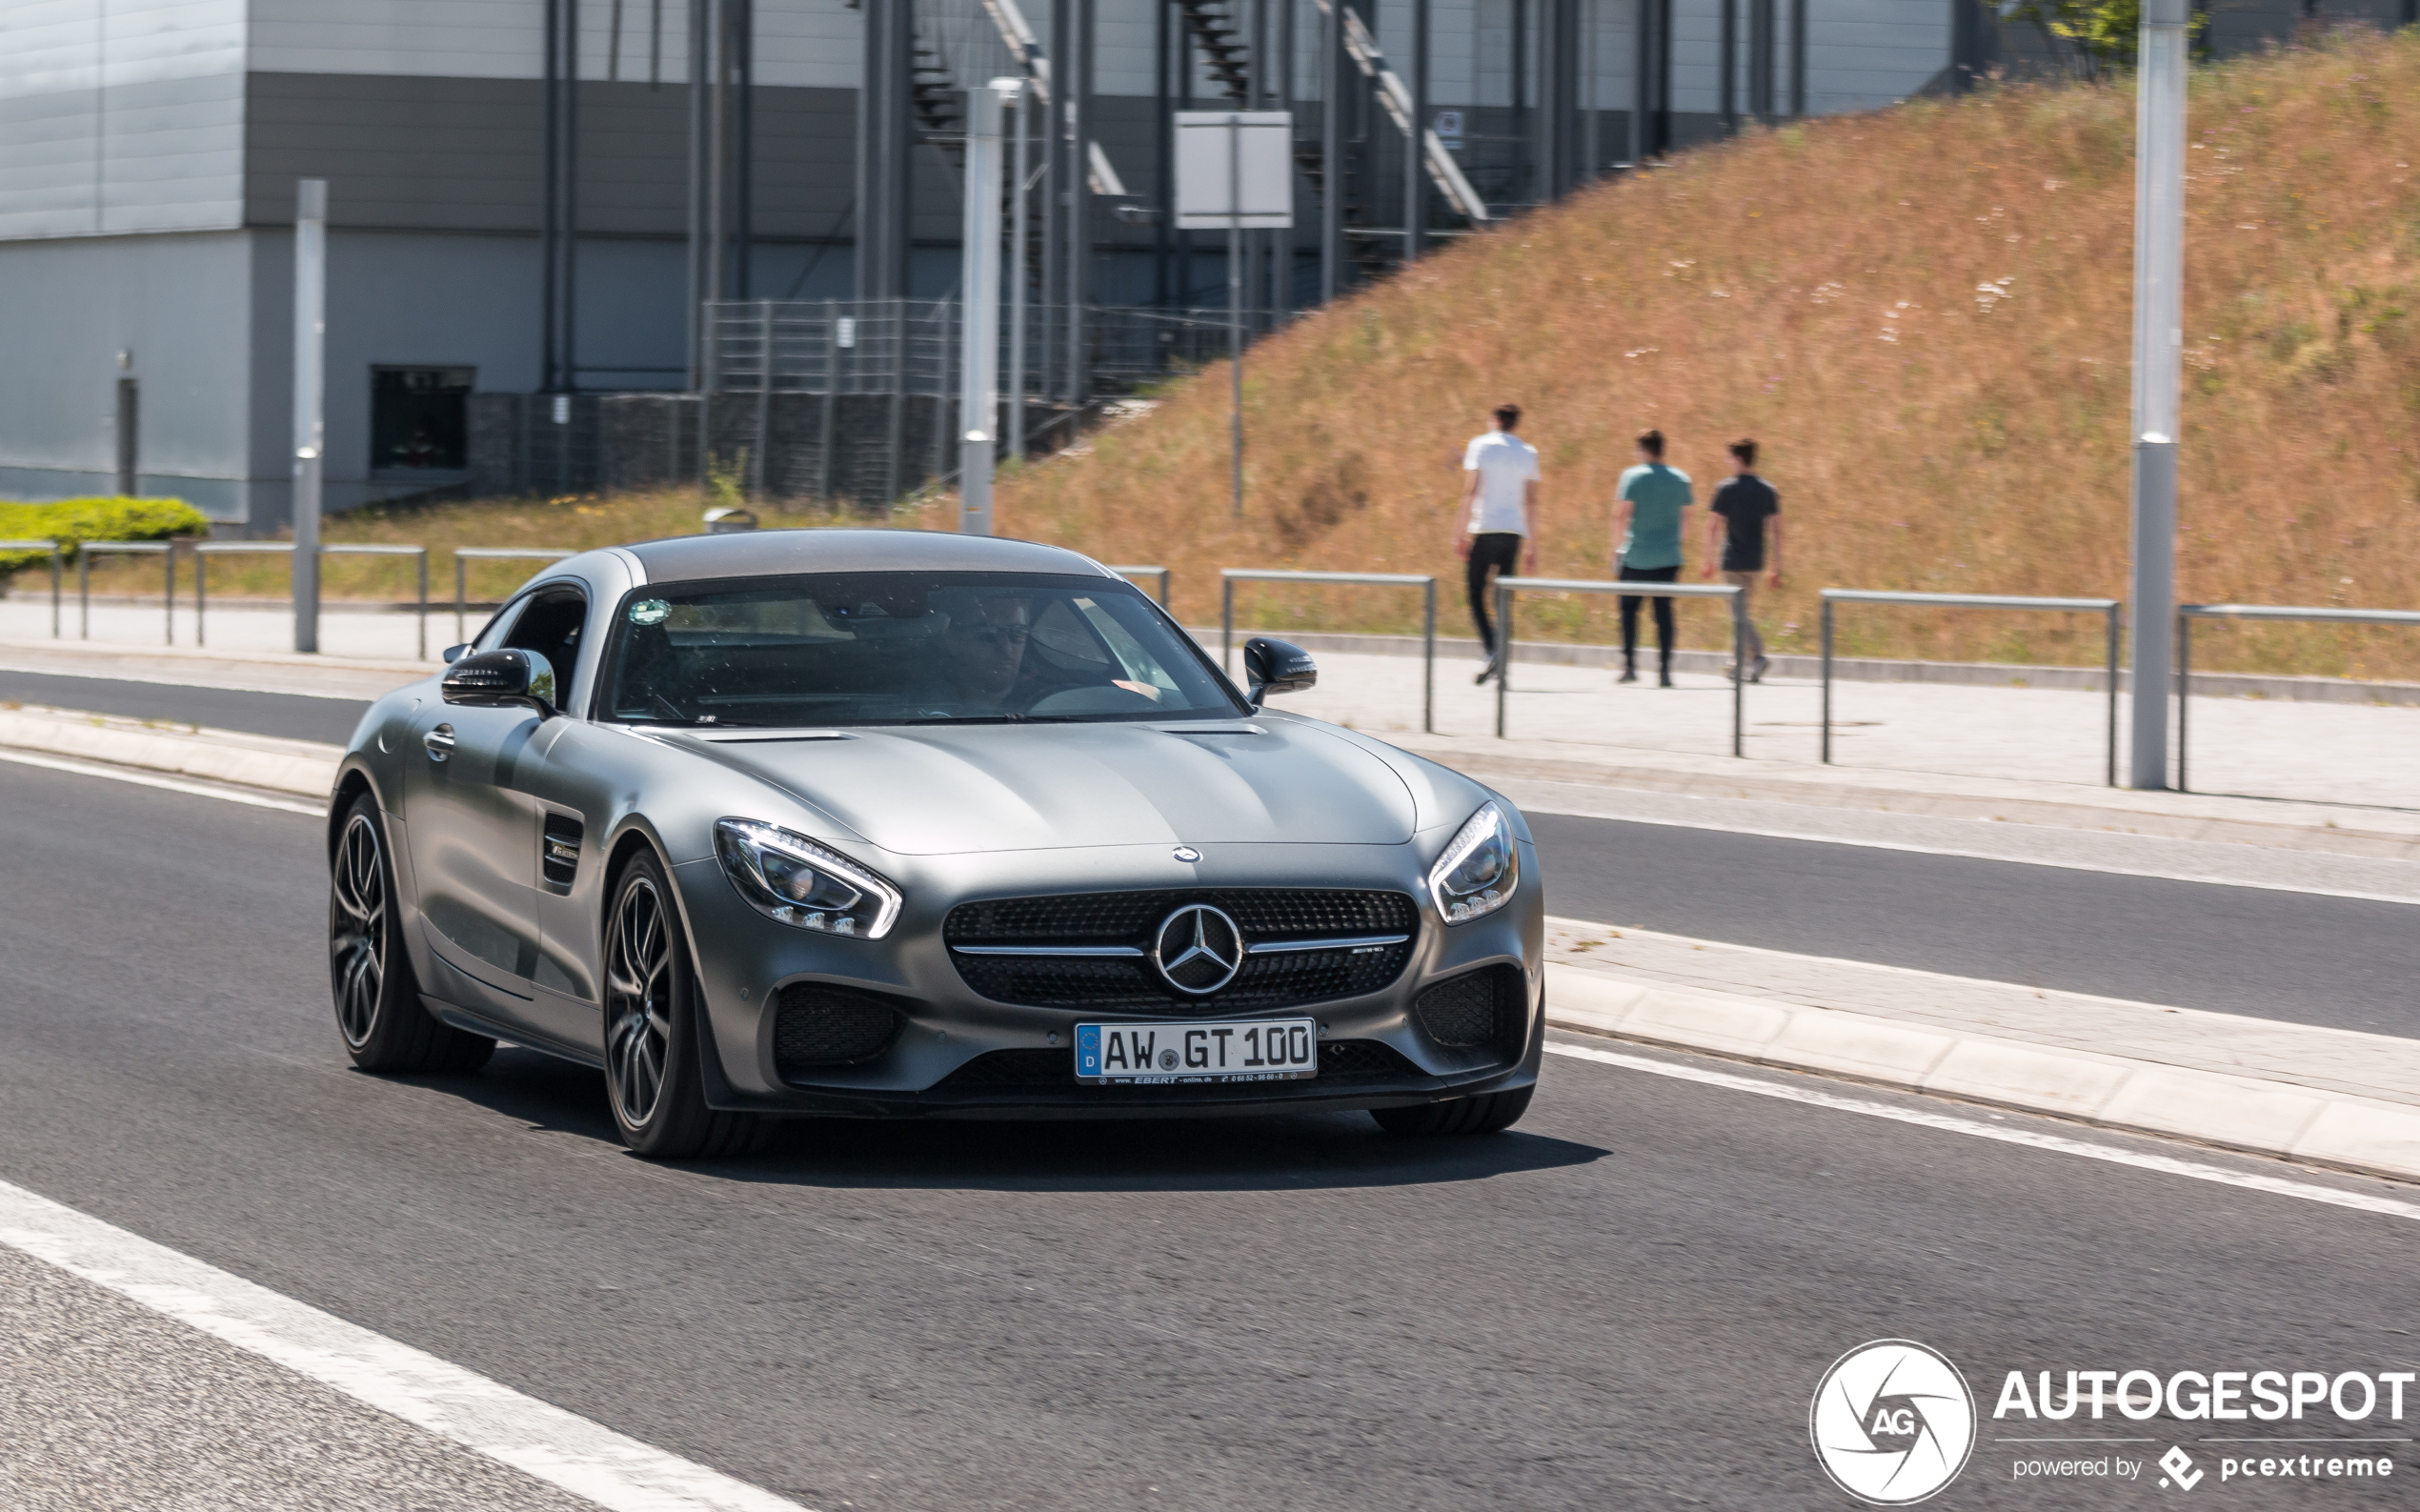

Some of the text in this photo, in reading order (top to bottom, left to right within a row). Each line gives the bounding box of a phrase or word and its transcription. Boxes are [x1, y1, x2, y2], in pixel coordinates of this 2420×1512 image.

[1085, 1056, 1095, 1067] D
[1104, 1026, 1309, 1070] AW GT 100
